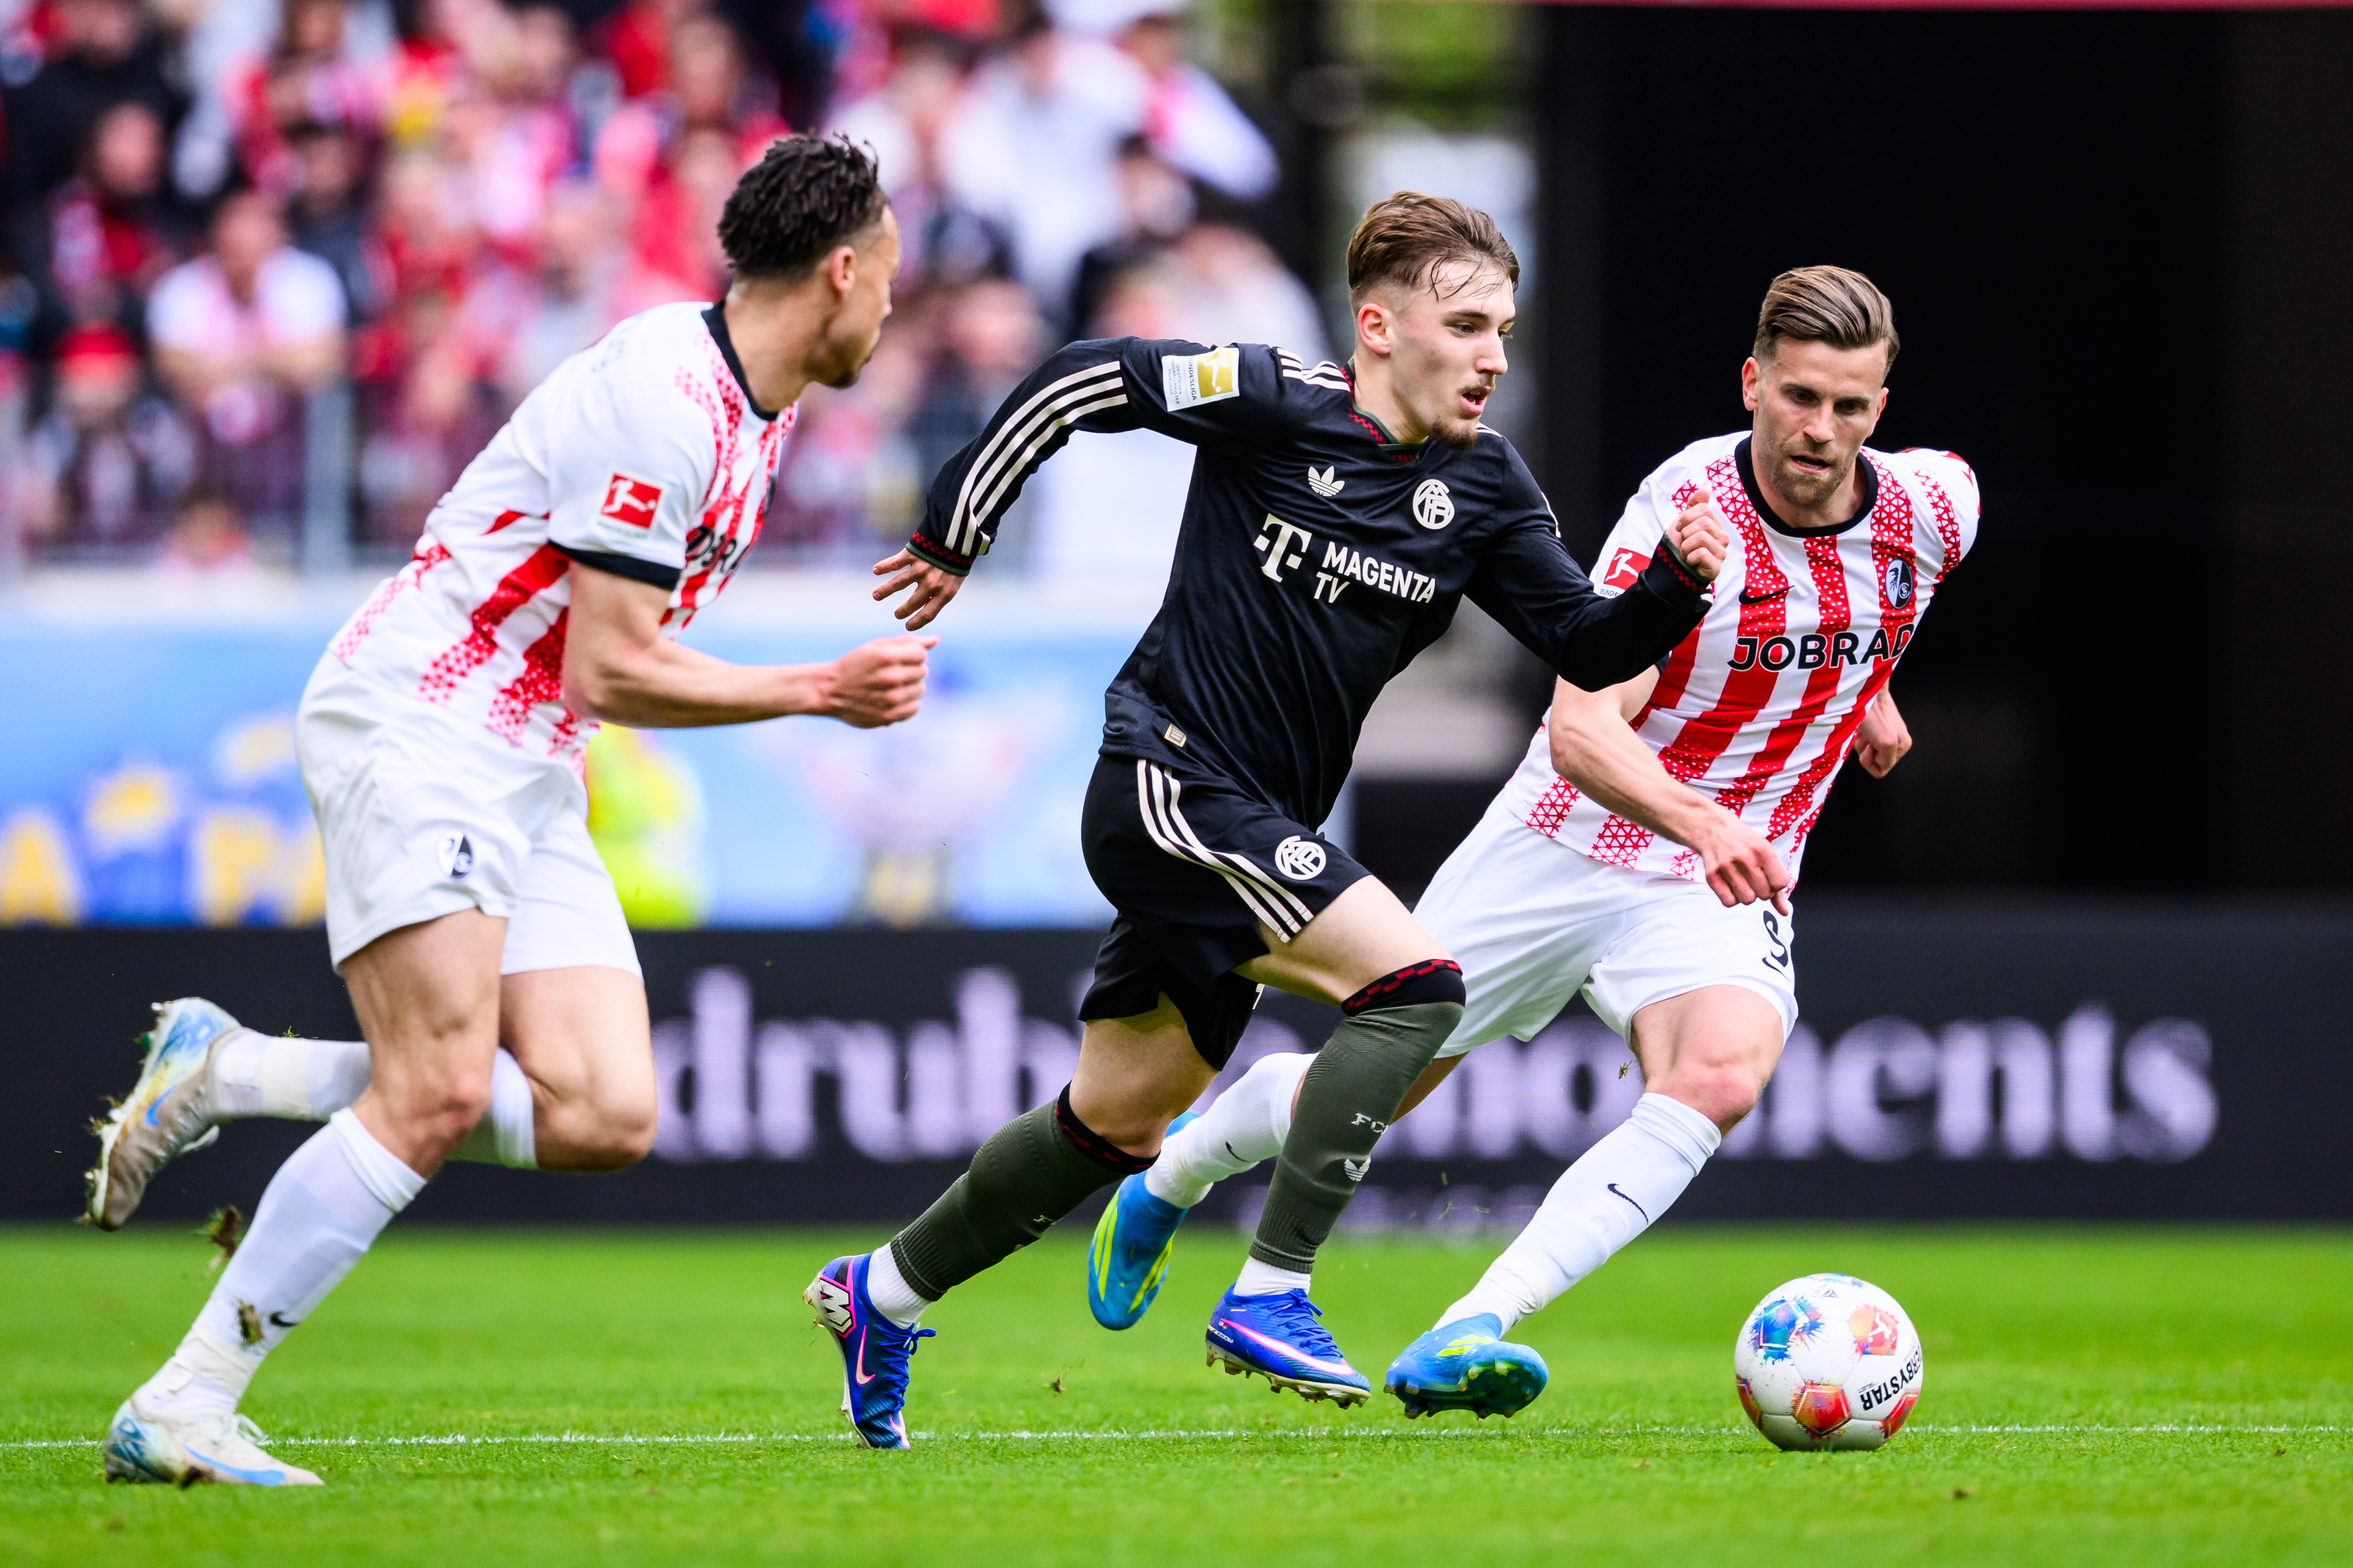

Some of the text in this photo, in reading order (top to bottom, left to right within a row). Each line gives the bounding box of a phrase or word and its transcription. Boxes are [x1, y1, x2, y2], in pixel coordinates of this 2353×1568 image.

[1314, 571, 1350, 604] TV
[1322, 541, 1436, 604] MAGENTA
[1599, 588, 1621, 597] BUNDE
[1727, 623, 1915, 672] JOBRAD
[1350, 1112, 1389, 1135] FC
